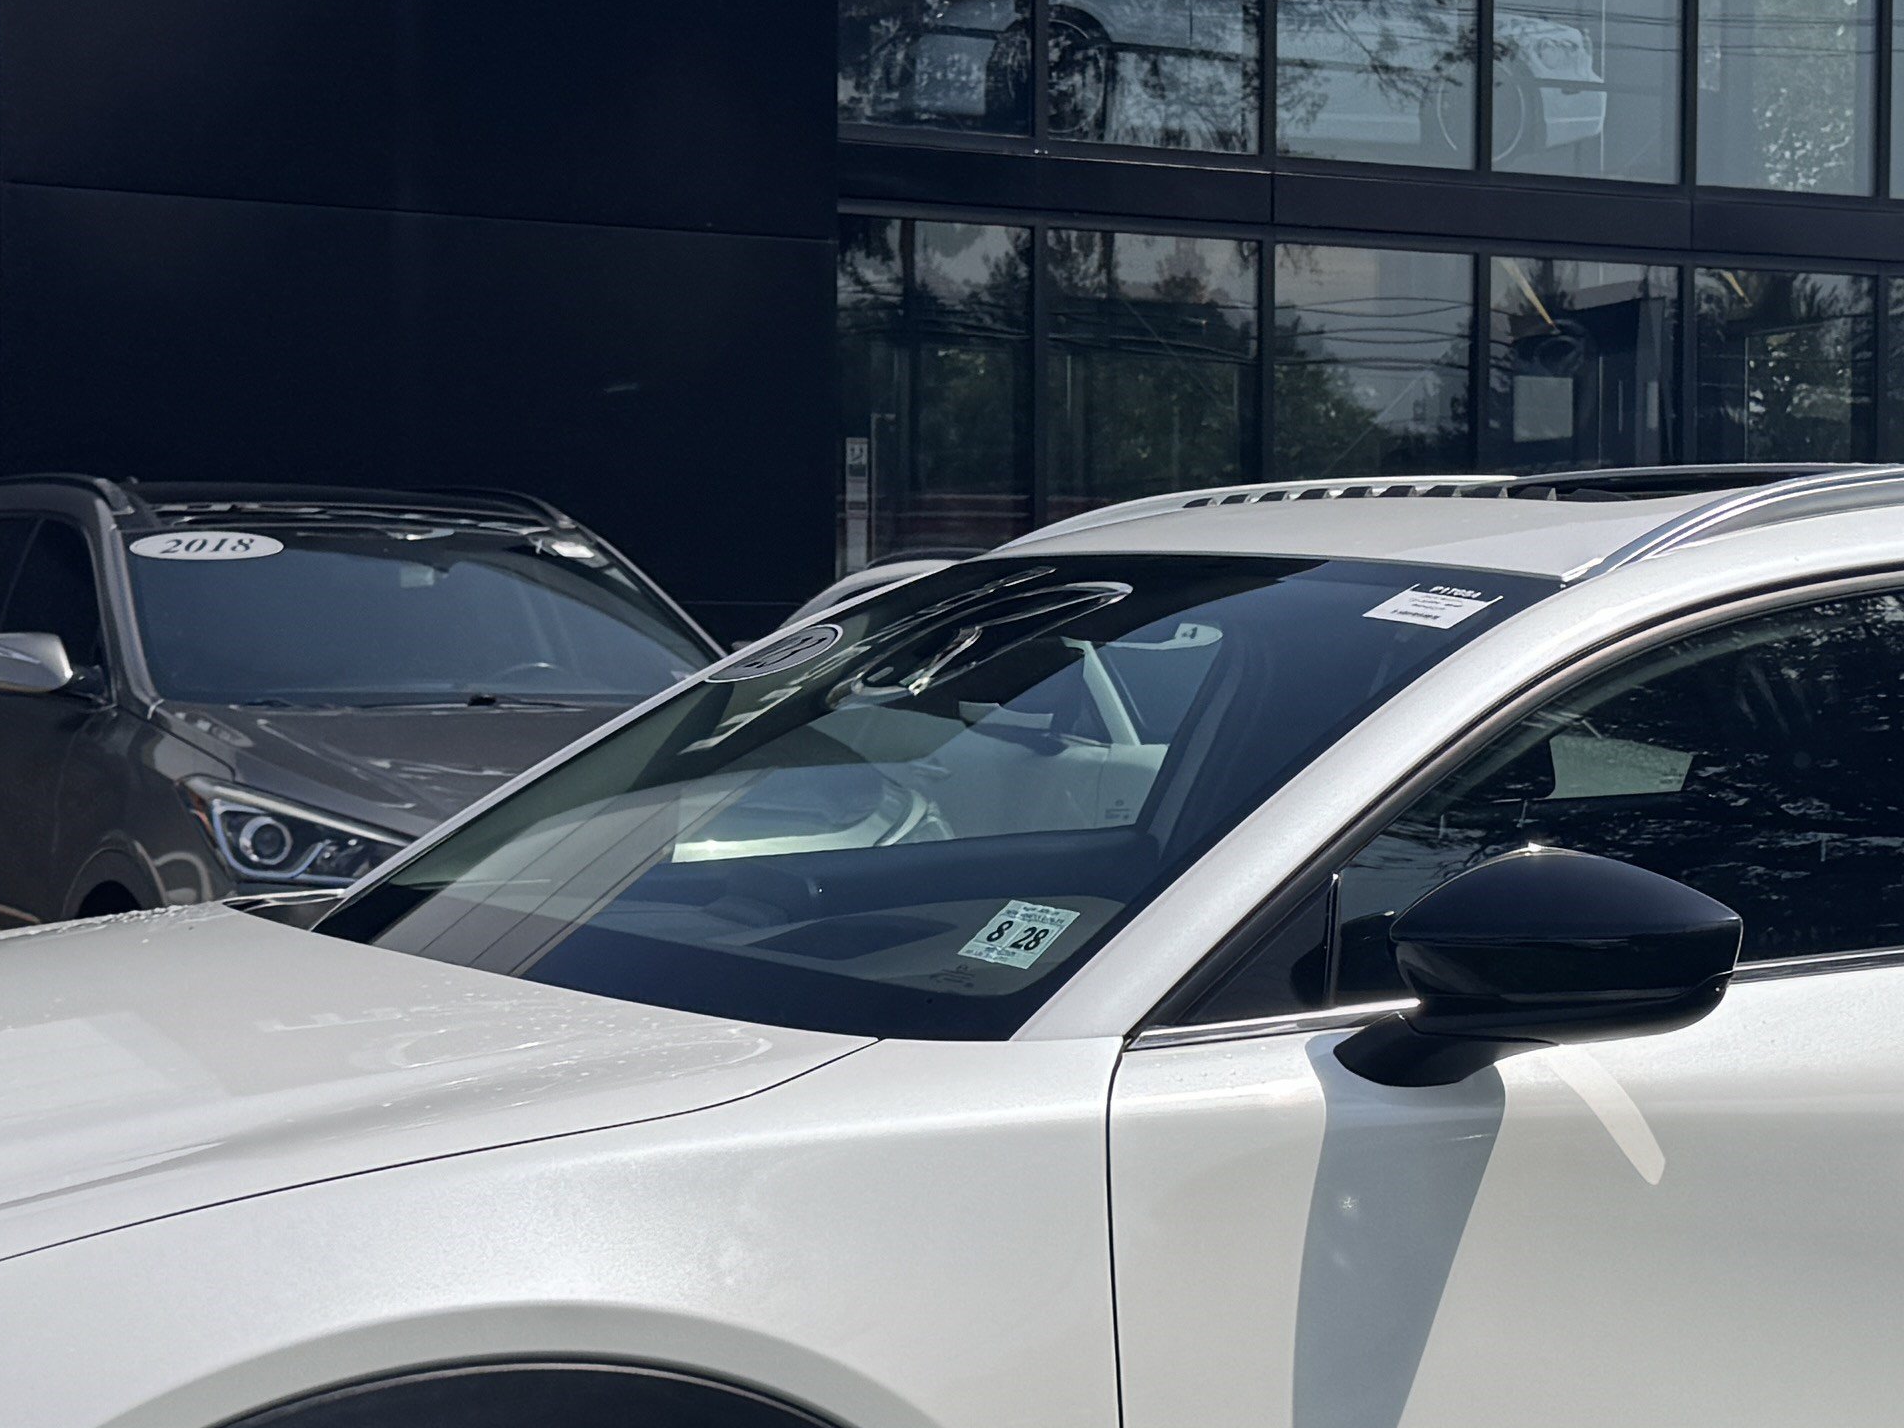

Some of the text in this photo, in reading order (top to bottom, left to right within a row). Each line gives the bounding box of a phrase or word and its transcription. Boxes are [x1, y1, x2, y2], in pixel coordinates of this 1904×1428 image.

[159, 537, 255, 555] 2018
[986, 919, 1050, 951] 8 28
